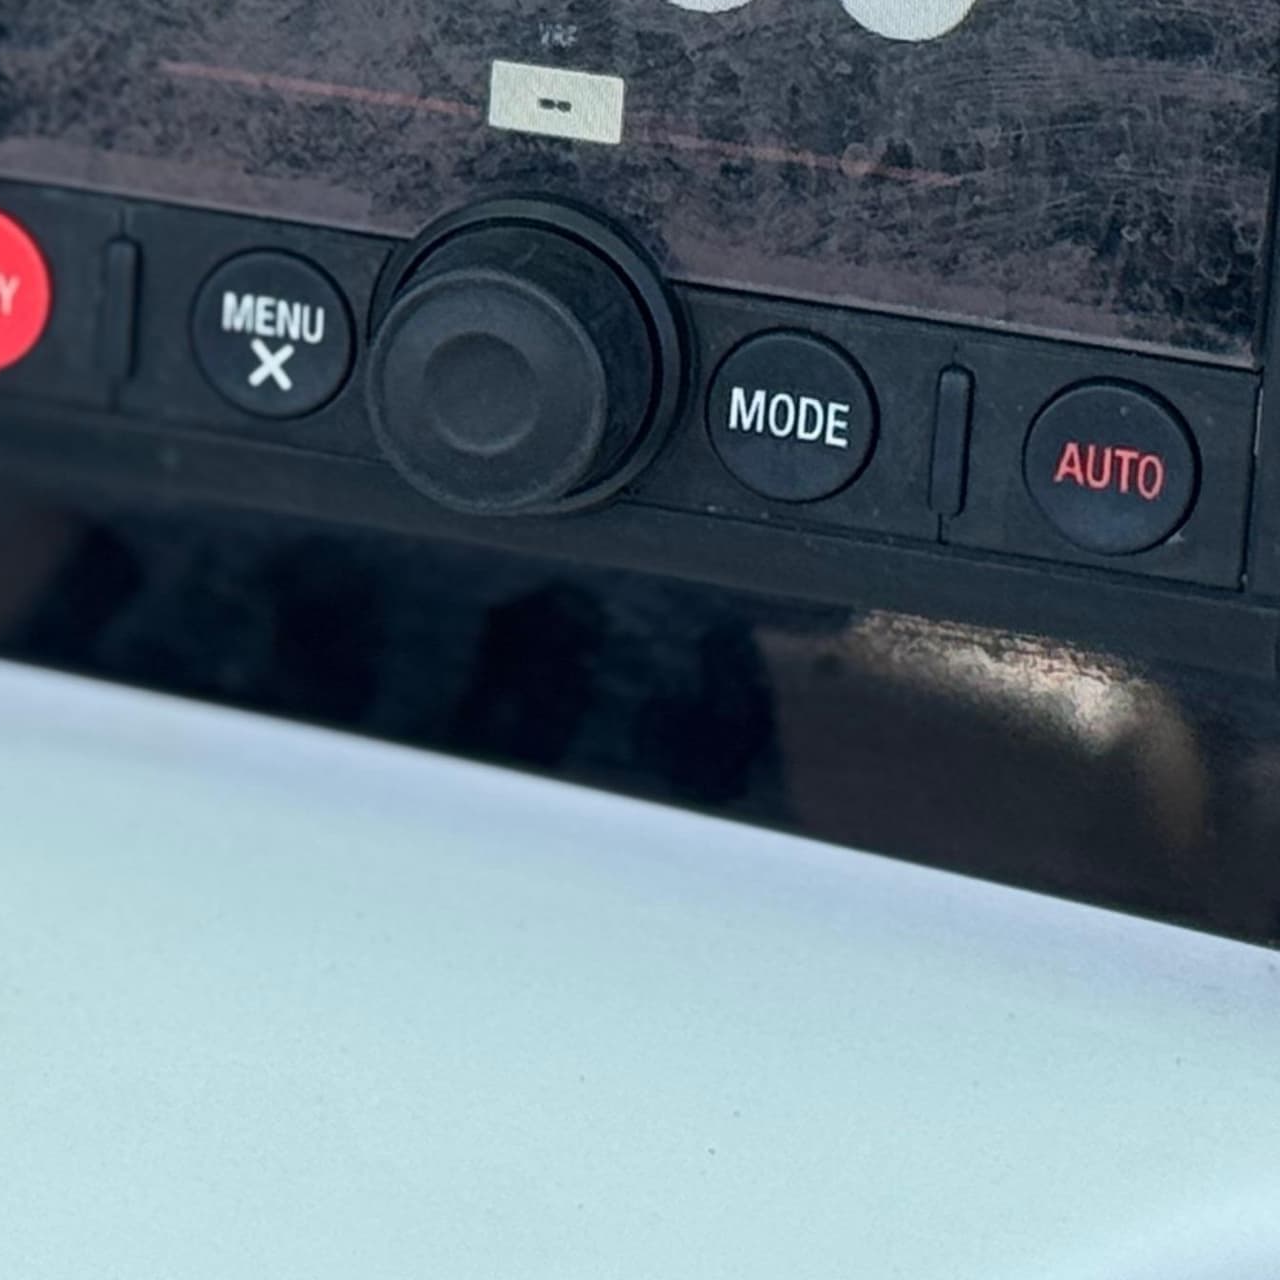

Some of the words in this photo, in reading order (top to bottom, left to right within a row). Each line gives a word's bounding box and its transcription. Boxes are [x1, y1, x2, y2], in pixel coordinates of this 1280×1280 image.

[222, 291, 324, 344] MENU
[728, 386, 850, 448] MODE
[1053, 441, 1164, 501] AUTO
